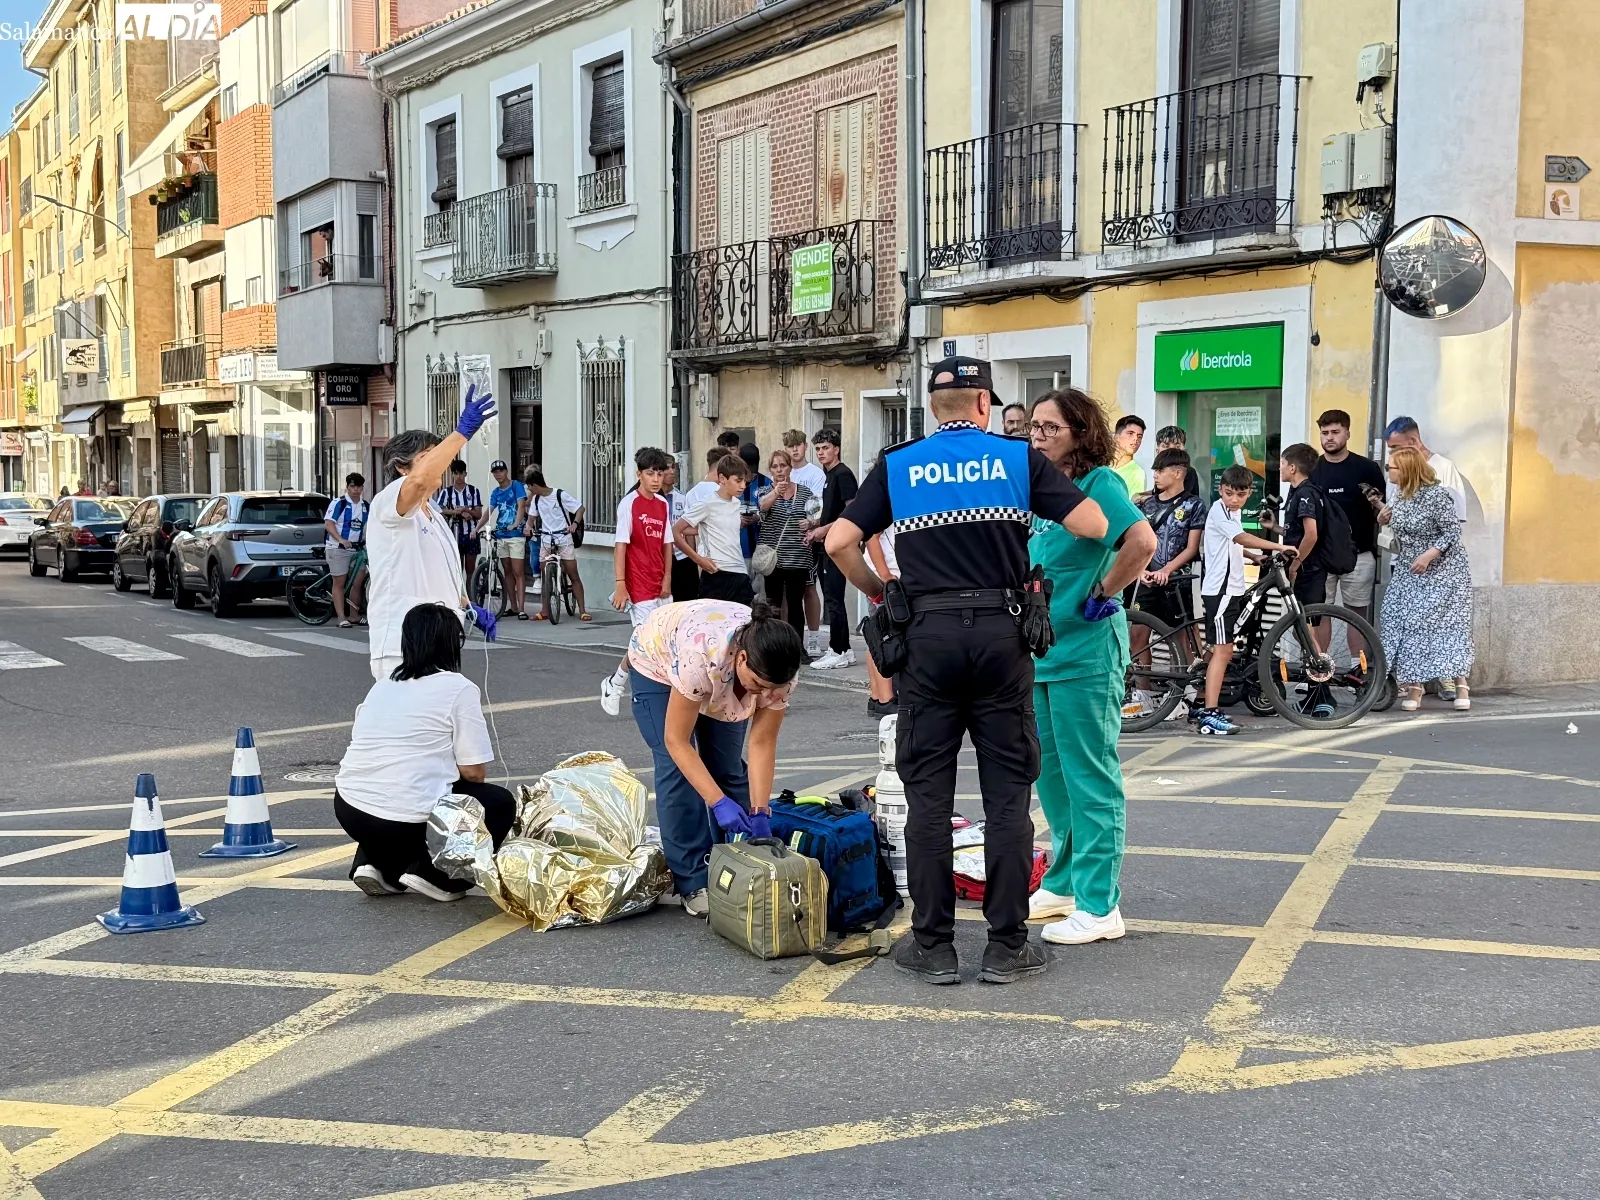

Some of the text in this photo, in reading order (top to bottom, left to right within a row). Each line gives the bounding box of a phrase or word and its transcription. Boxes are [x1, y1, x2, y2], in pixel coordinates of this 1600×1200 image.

[795, 248, 829, 268] VENDE
[945, 342, 954, 356] 31
[1201, 350, 1252, 369] Iberdrola
[327, 375, 360, 384] COMPRO
[335, 384, 352, 393] ORO
[908, 453, 1008, 488] POLICÍA
